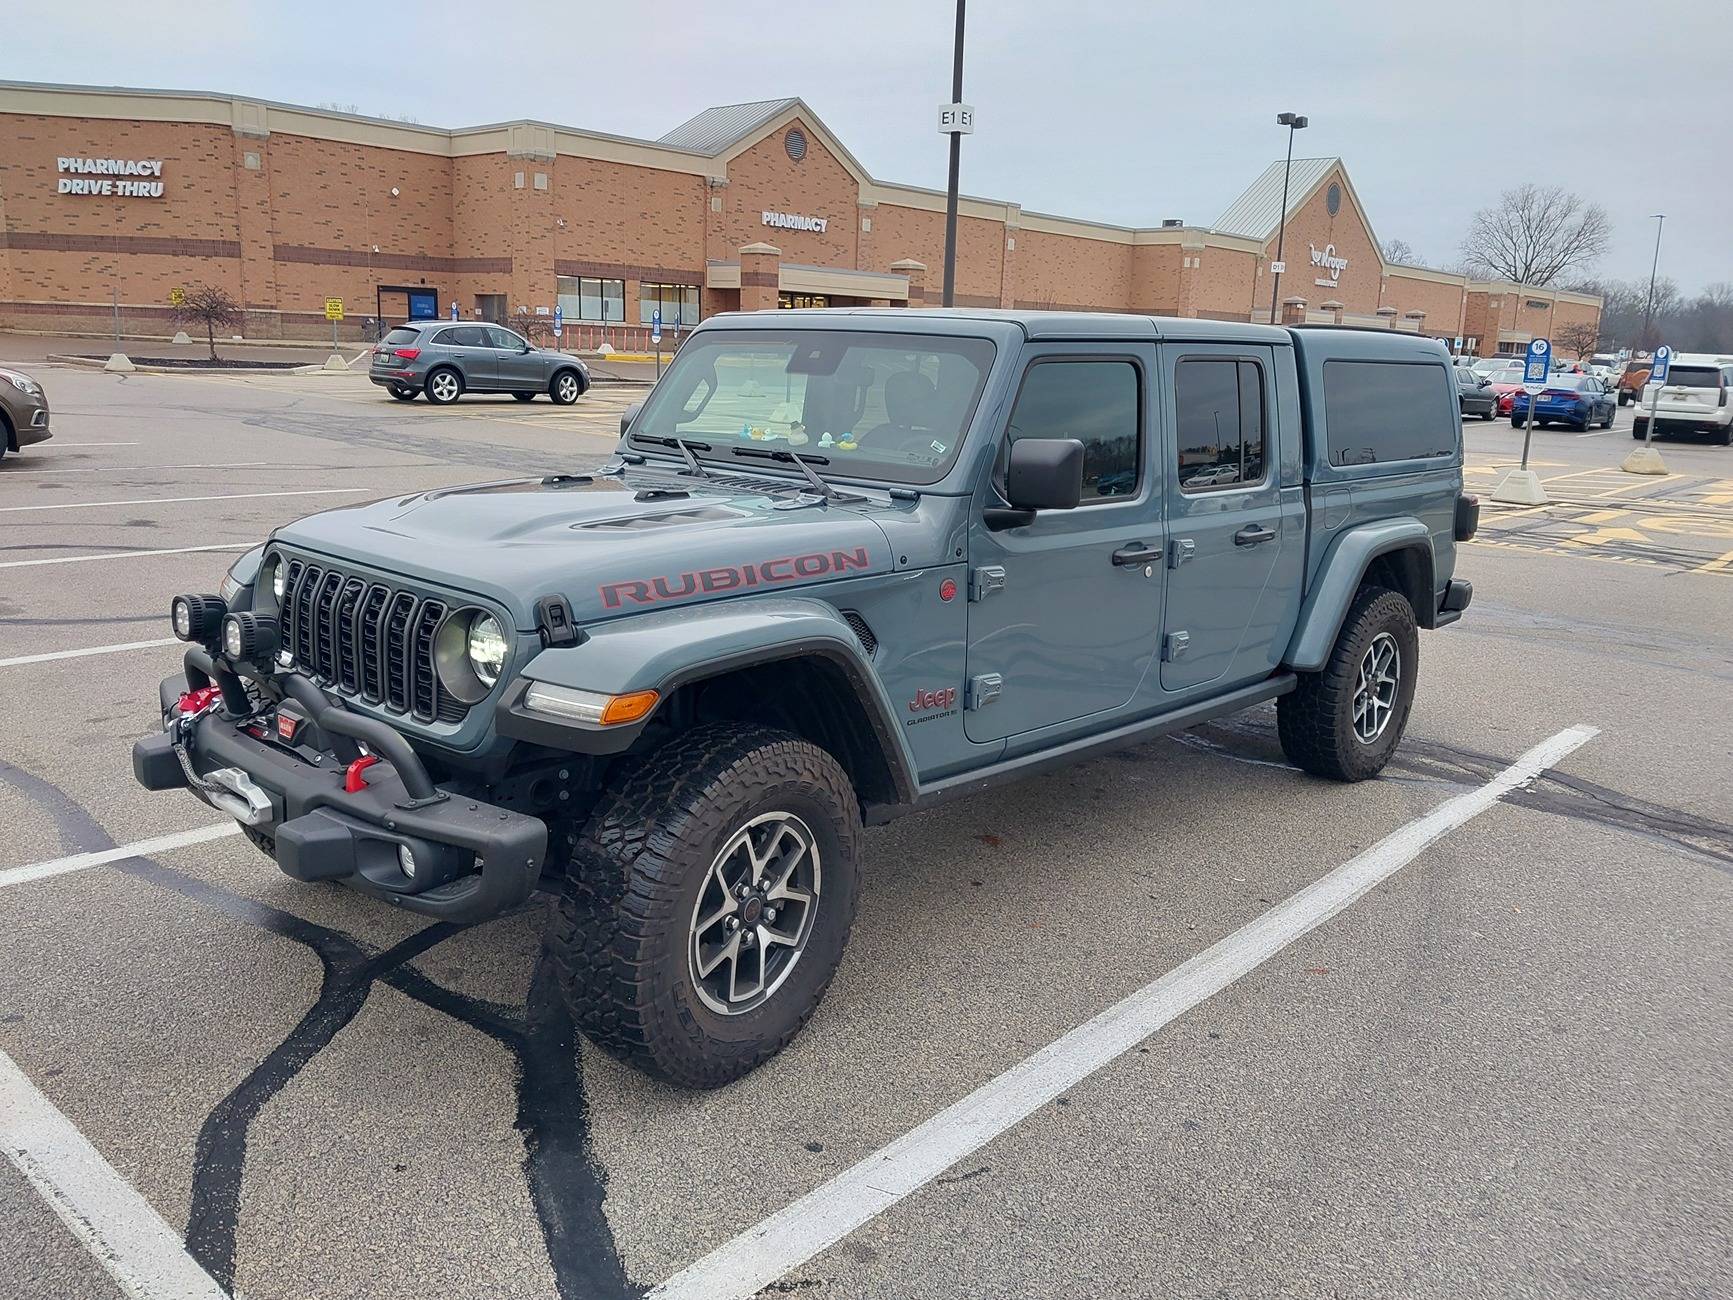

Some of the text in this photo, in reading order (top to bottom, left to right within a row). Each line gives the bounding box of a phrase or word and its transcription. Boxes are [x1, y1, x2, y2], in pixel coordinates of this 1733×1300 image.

[942, 111, 956, 124] E1
[961, 111, 973, 126] E1
[57, 157, 163, 176] PHARMACY
[57, 178, 164, 197] DRIVE-THRU
[761, 211, 828, 233] PHARMACY
[1321, 244, 1348, 280] Kroger
[1535, 343, 1545, 351] 16
[598, 545, 871, 609] RUBICON
[908, 687, 955, 713] Jeep
[906, 711, 950, 726] GLADIATOR
